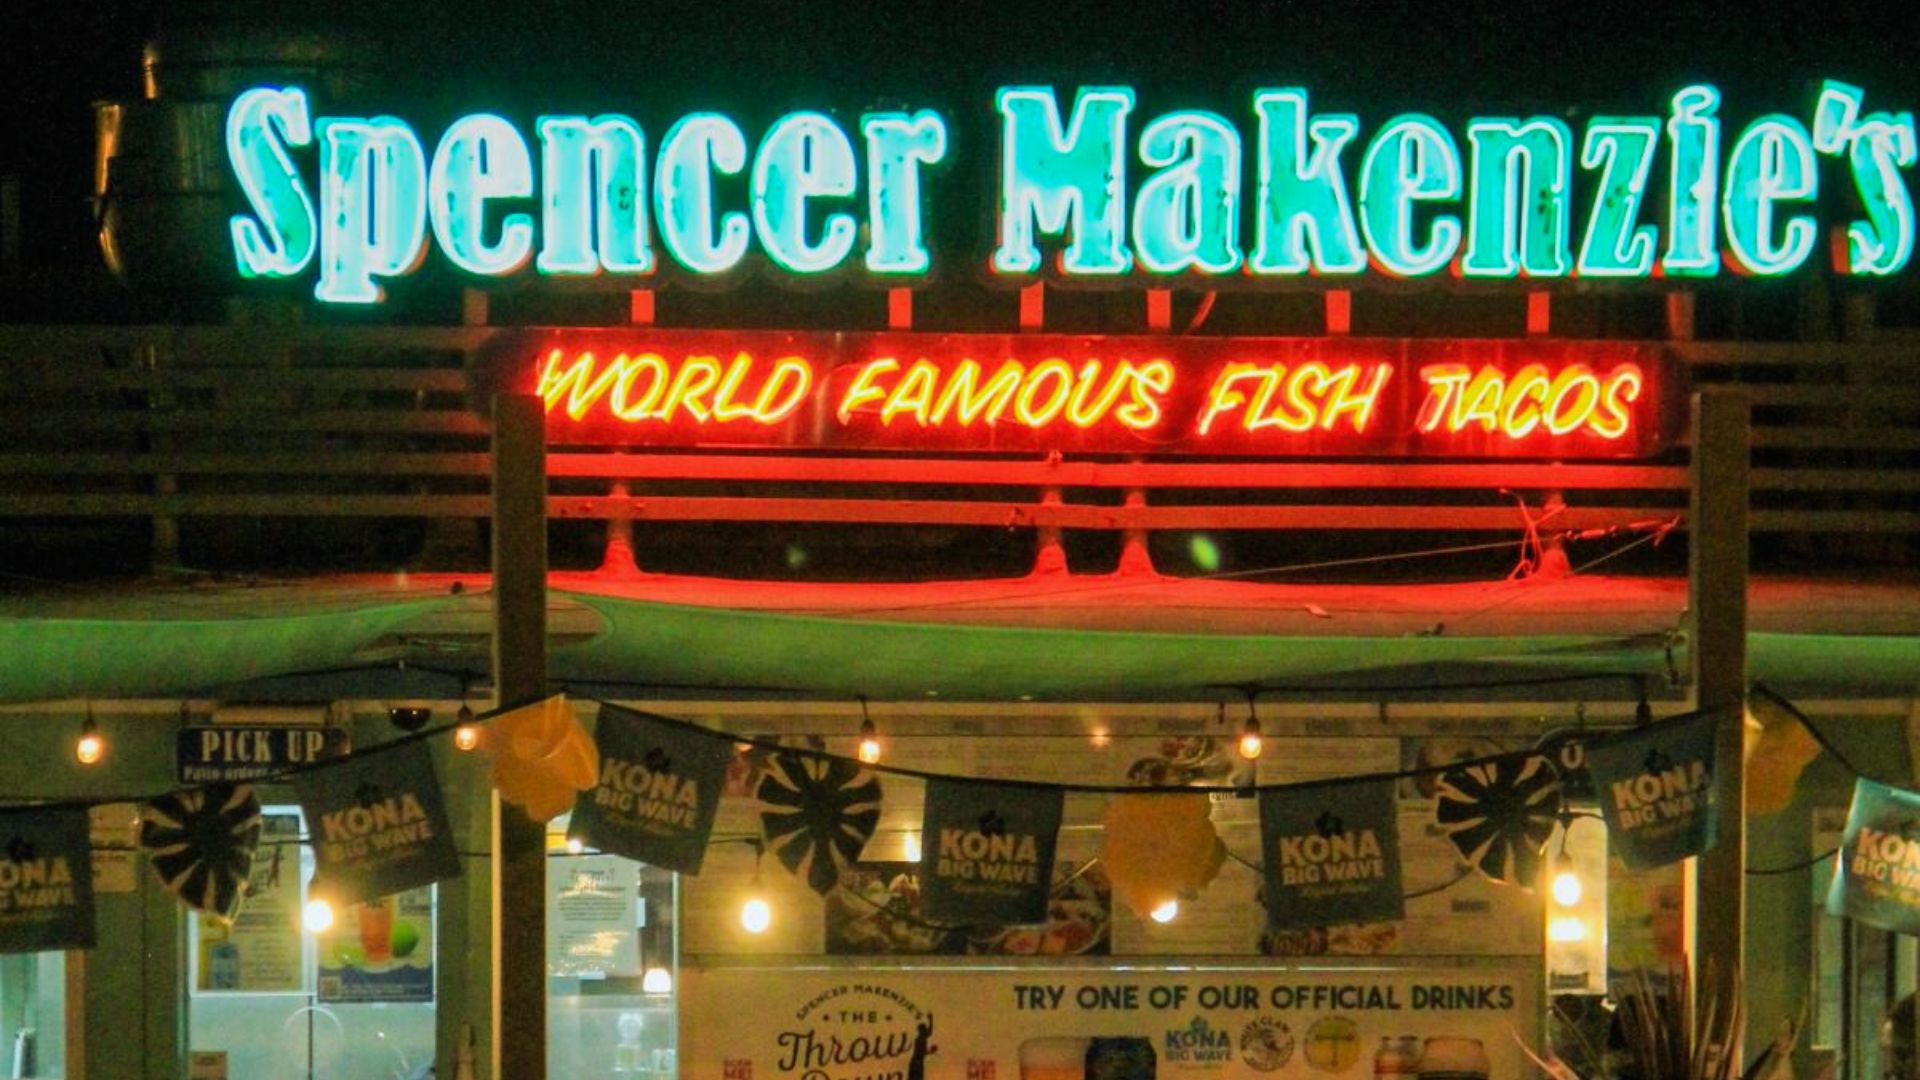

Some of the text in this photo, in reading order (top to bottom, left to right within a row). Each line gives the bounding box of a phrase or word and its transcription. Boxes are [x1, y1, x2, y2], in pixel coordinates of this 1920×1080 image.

[227, 79, 1917, 303] Spencer Makenzie's
[537, 350, 1642, 439] WORLD FAMOUS FISH TACOS
[202, 731, 324, 762] PICK UP
[600, 758, 699, 808] KONA
[321, 792, 427, 841] KONA
[595, 785, 634, 812] BIG
[637, 796, 697, 829] WAVE
[1617, 795, 1695, 831] BIG WA
[370, 818, 434, 851] WAVE
[939, 827, 1038, 863] KONA
[1279, 829, 1382, 867] KONA
[1857, 826, 1920, 871] KON
[0, 856, 73, 889] ONA
[937, 859, 1038, 885] BIG WAVE
[1282, 858, 1385, 886] BIG WAVE
[1852, 854, 1888, 881] BIG
[15, 886, 77, 909] WAVE
[795, 985, 849, 1021] SPENCER
[1014, 986, 1515, 1010] TRY ONE OF OUR OFFICIAL DRINKS
[839, 1011, 878, 1023] THE
[777, 1029, 913, 1072] Throw
[1165, 1030, 1231, 1049] KONA
